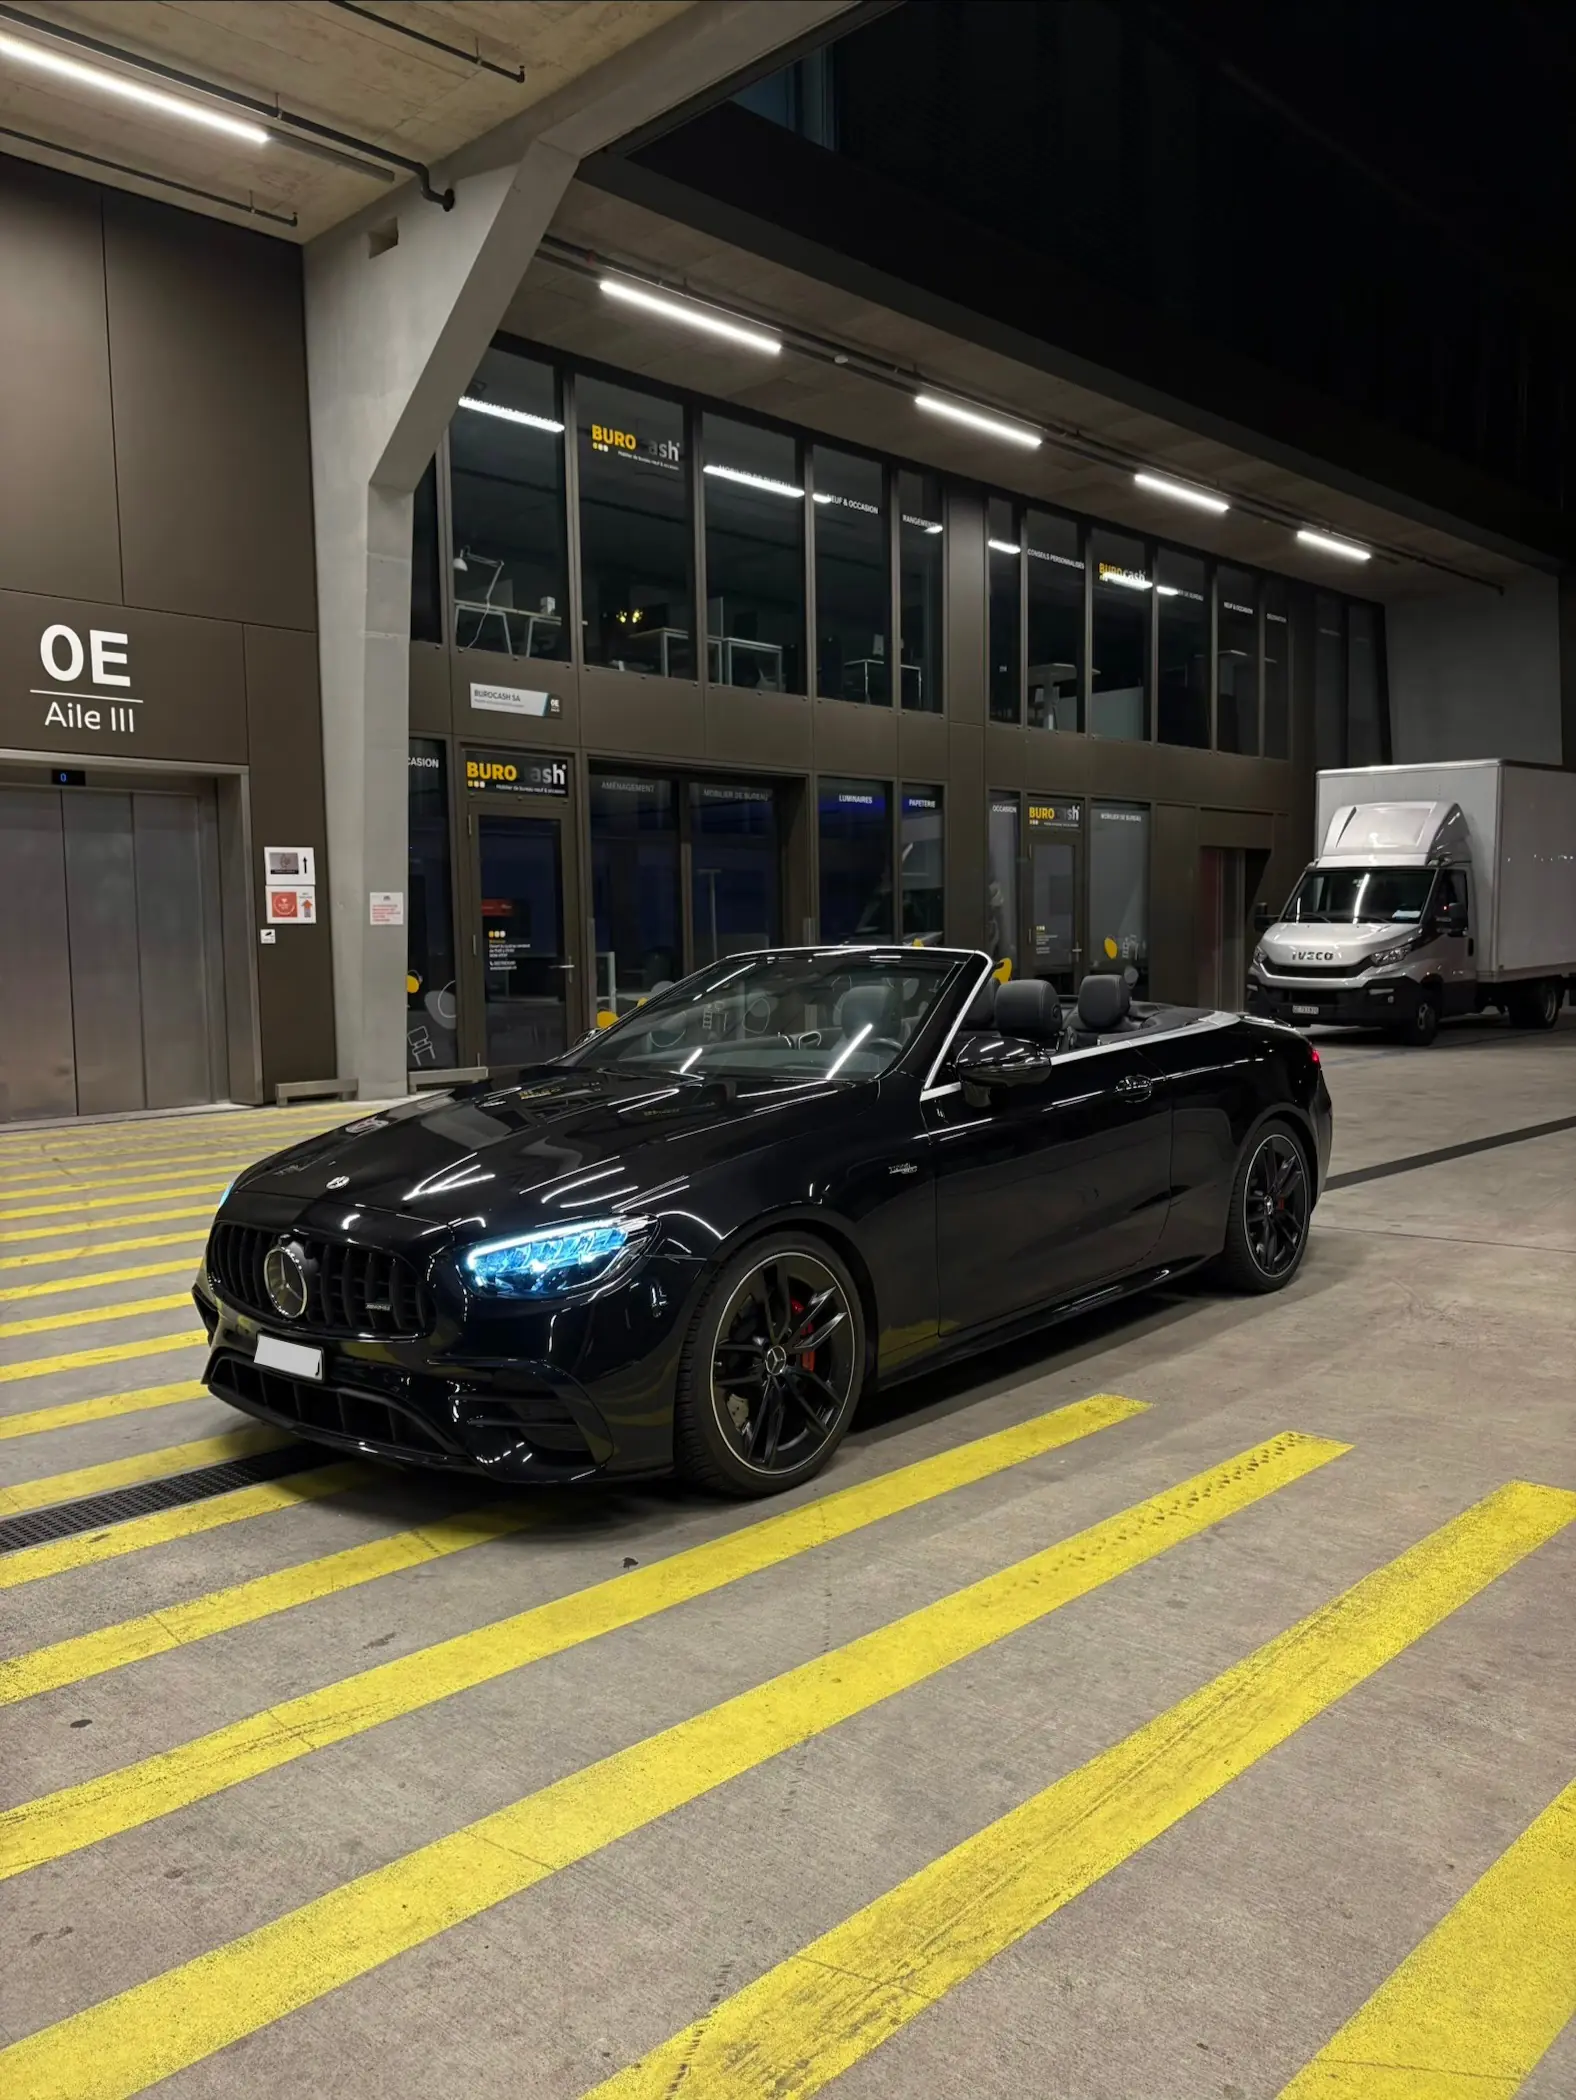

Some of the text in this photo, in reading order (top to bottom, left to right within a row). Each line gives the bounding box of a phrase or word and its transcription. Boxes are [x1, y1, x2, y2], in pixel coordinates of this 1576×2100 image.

[849, 499, 879, 514] OCCASION
[474, 689, 521, 702] BUROCASH SA
[45, 701, 135, 732] Aile III
[839, 794, 873, 804] LUMINAIRES
[908, 799, 936, 808] PAPETERIE
[1292, 951, 1334, 961] IVECO
